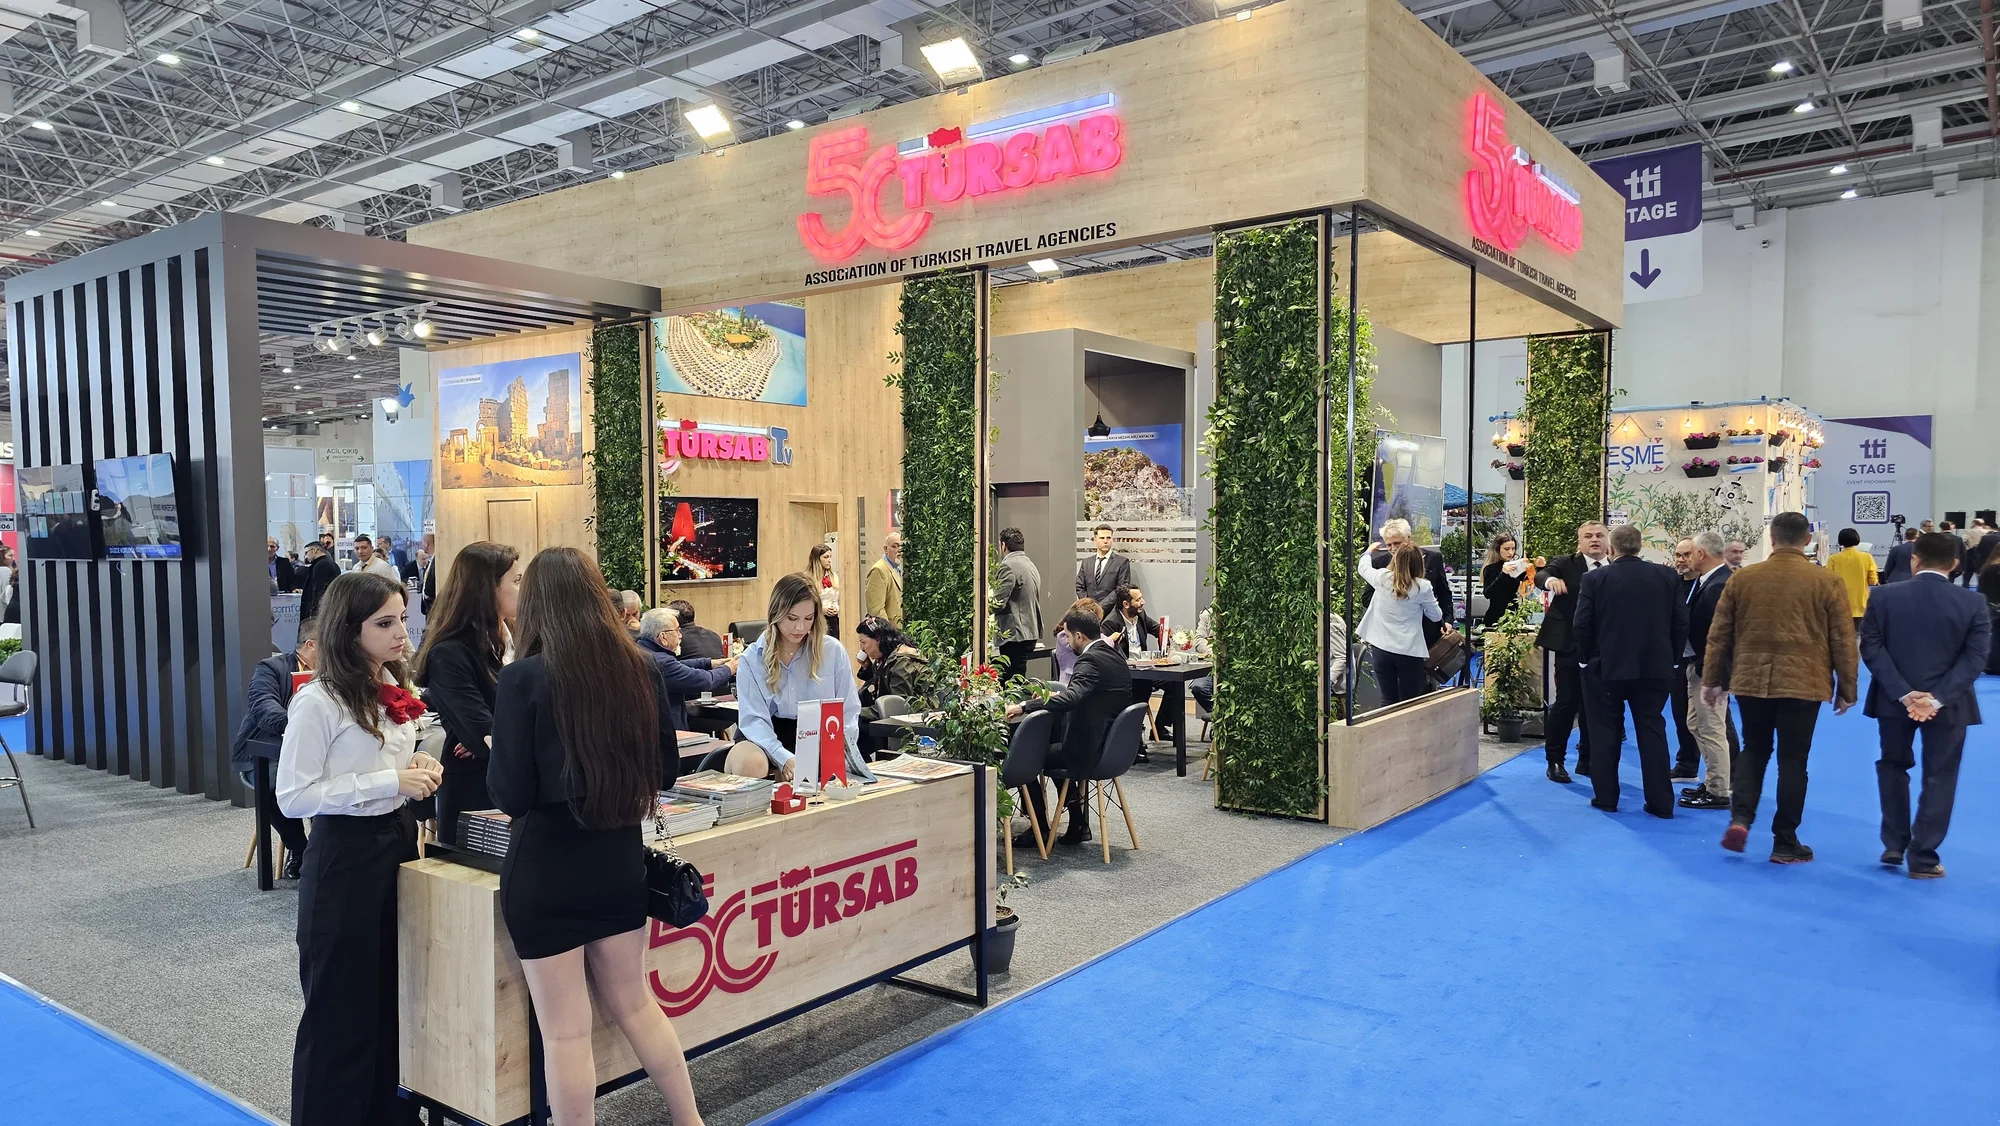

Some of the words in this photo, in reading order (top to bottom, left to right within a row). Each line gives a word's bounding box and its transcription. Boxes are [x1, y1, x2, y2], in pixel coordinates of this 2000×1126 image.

[898, 115, 1121, 208] TÜRSAB
[1623, 165, 1661, 200] tti
[1626, 201, 1678, 224] TAGE
[804, 261, 886, 286] ASSOCIATION
[890, 258, 907, 273] OF
[911, 247, 971, 269] TURKISH
[976, 237, 1032, 259] TRAVEL
[1037, 222, 1116, 249] AGENCIES
[1471, 236, 1509, 266] ASSOCIATION
[1508, 256, 1516, 270] OF
[1517, 259, 1538, 282] TURKISH
[1538, 271, 1556, 291] TRAVEL
[1556, 281, 1577, 301] AGENCIES
[664, 429, 770, 462] TÜRSAB
[1609, 444, 1664, 471] EŞME
[1859, 438, 1886, 459] tti
[1849, 463, 1896, 475] STAGE
[272, 604, 300, 613] comfo
[751, 856, 919, 949] TÜRSAB
